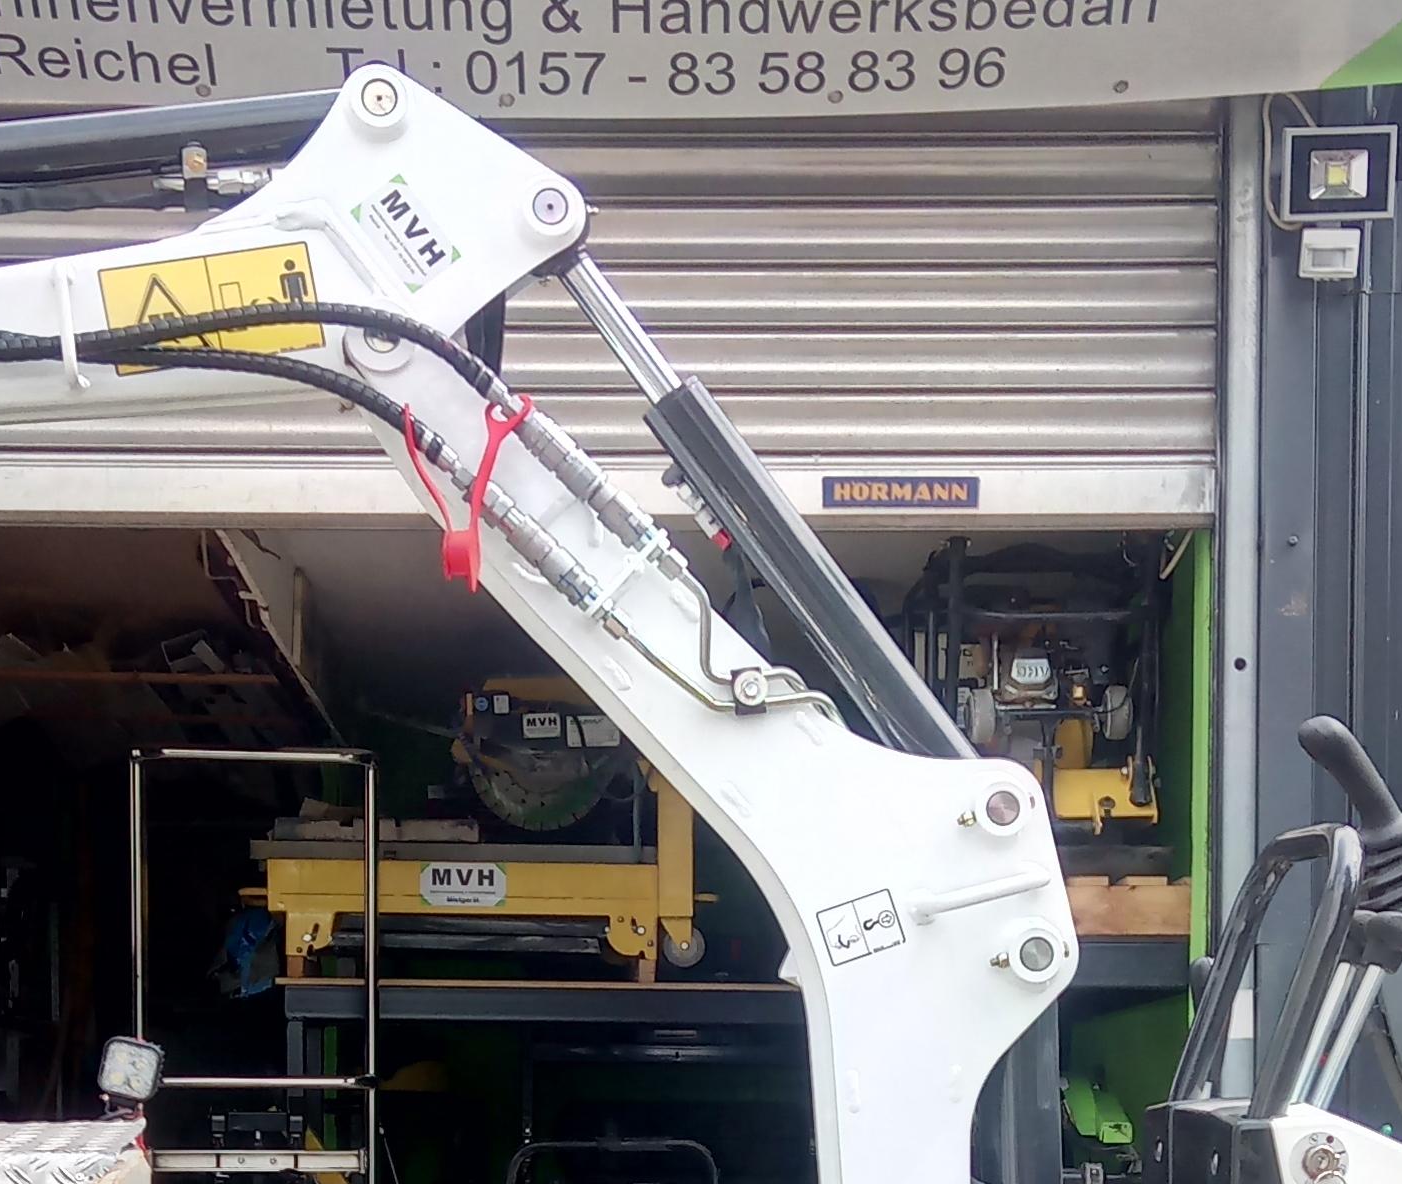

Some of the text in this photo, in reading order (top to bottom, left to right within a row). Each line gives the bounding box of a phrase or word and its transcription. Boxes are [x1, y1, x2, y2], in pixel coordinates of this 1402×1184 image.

[466, 51, 606, 95] 0157
[668, 52, 736, 95] 83
[758, 51, 826, 94] 58
[847, 50, 916, 92] 83
[938, 47, 1007, 88] 96
[380, 189, 446, 267] MVH
[833, 480, 968, 504] HÖRMANN
[526, 717, 558, 727] MVH
[431, 868, 494, 886] MVH
